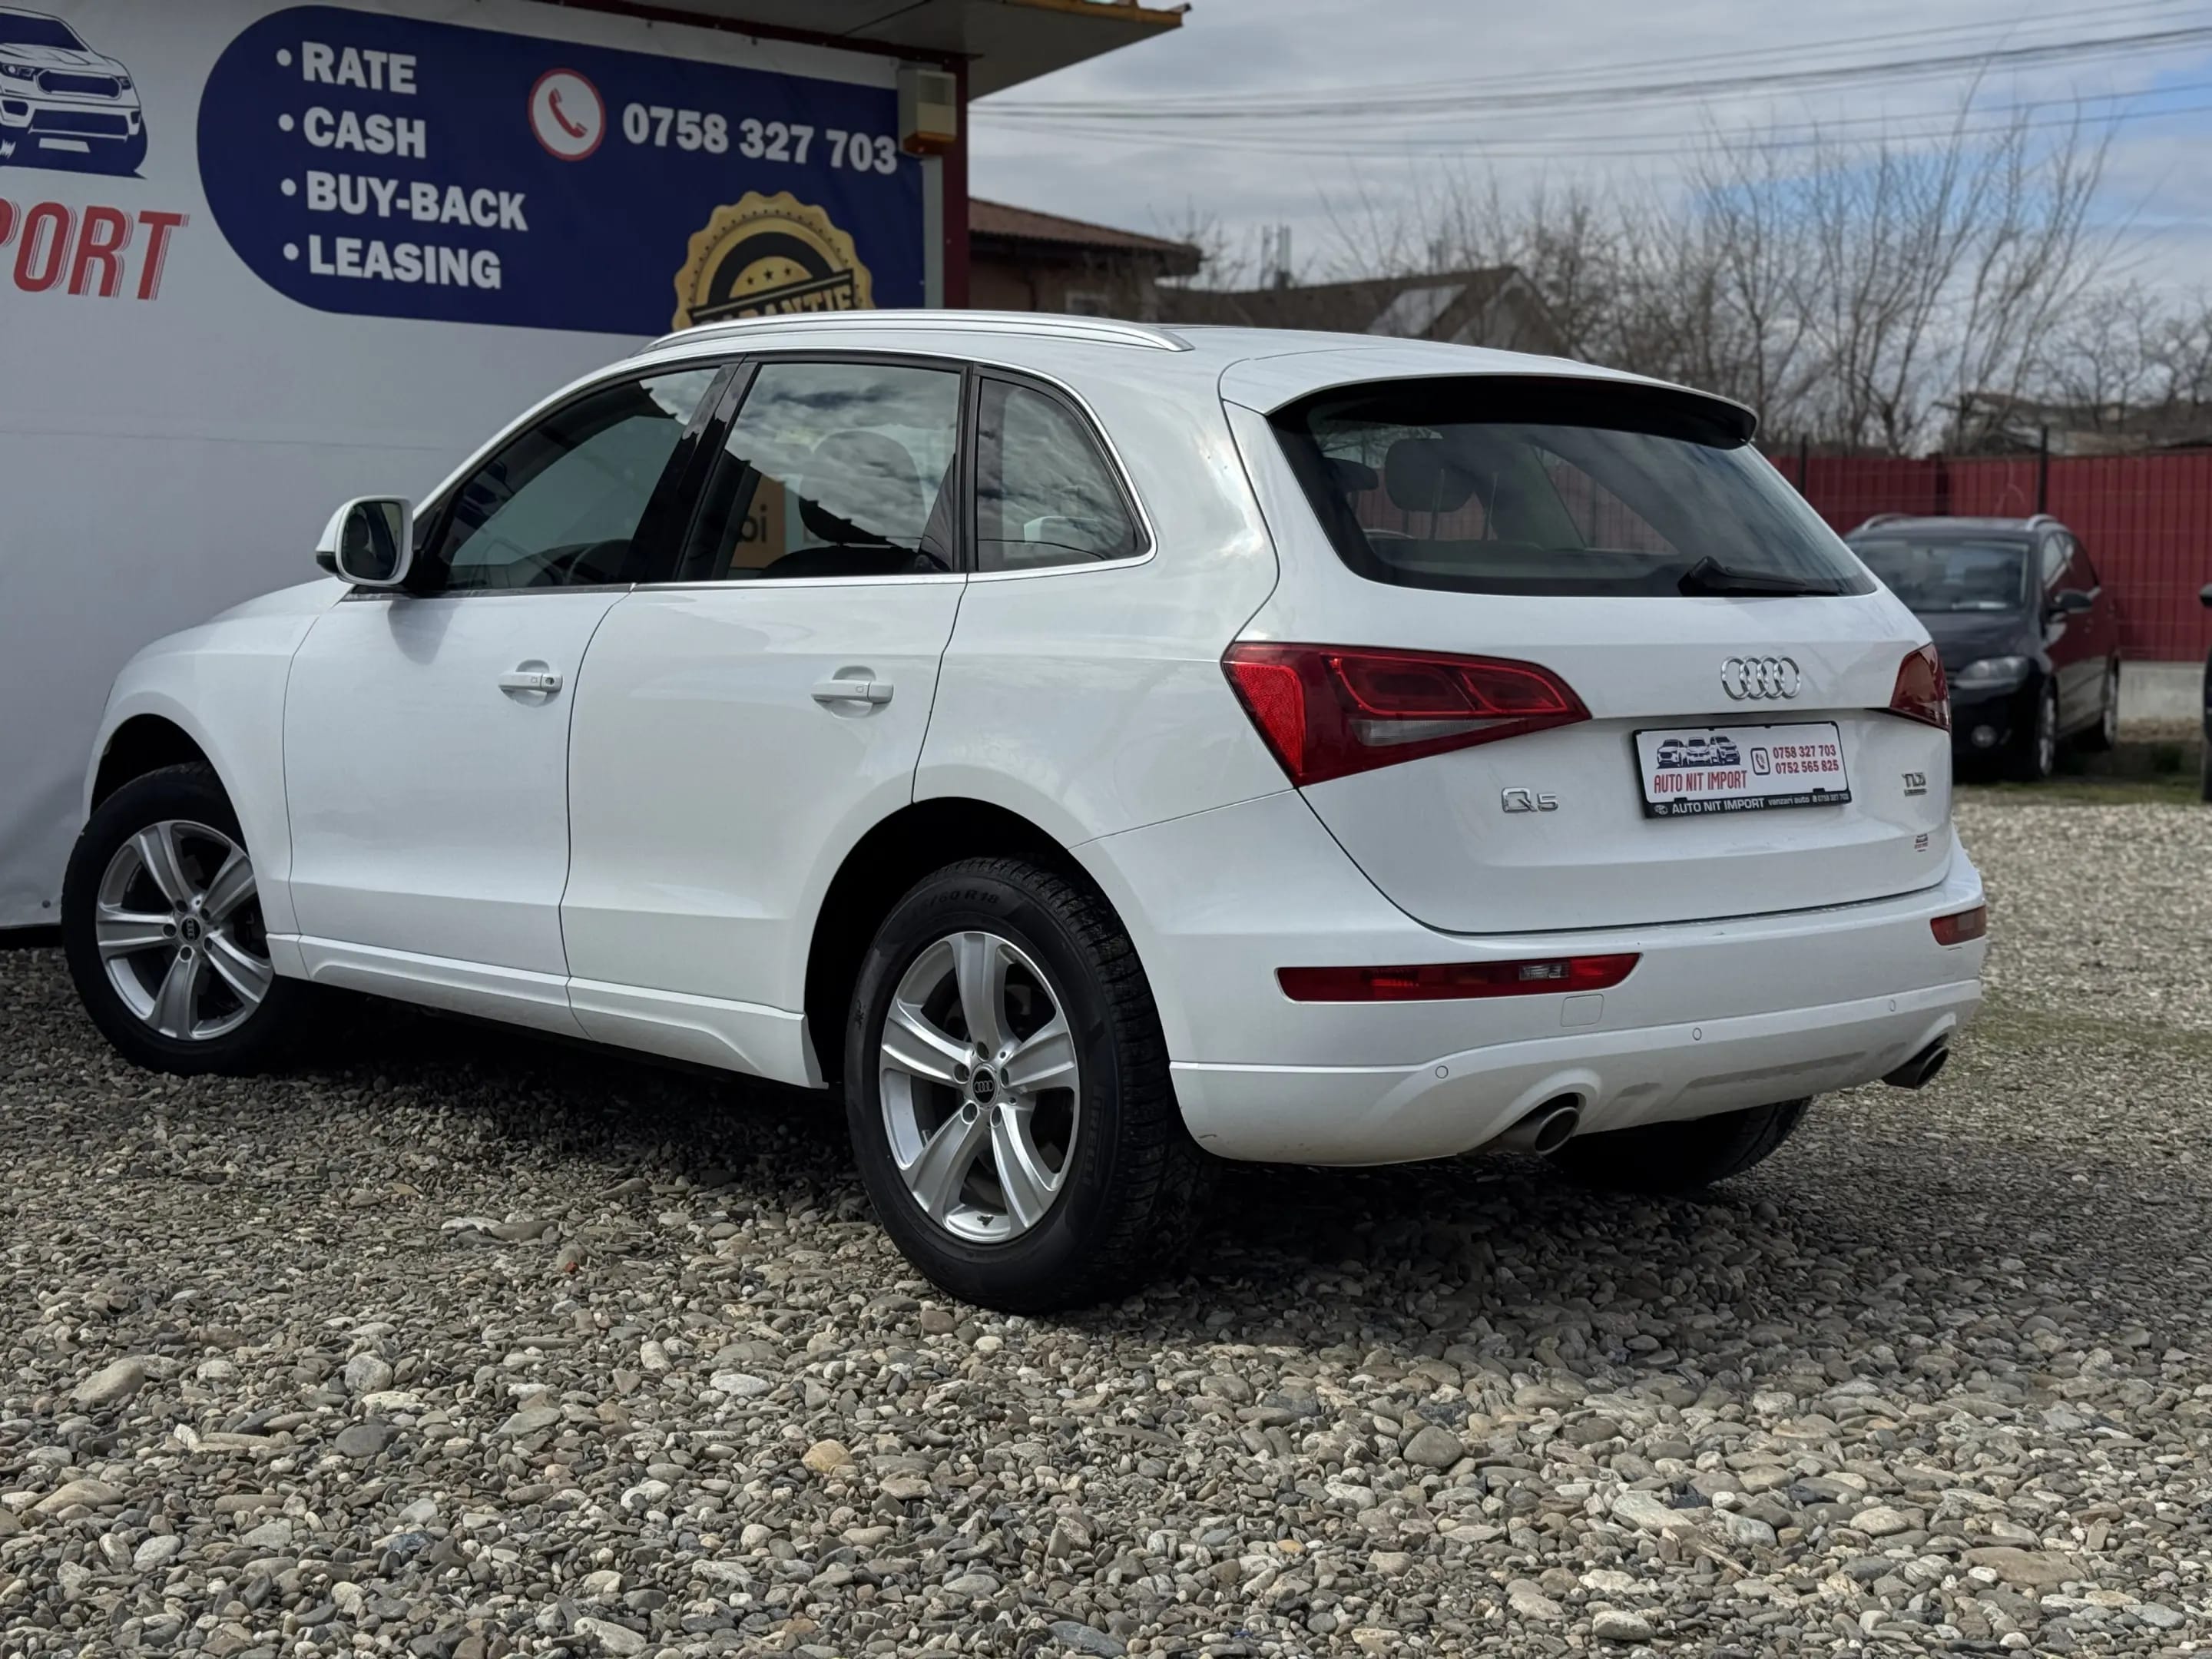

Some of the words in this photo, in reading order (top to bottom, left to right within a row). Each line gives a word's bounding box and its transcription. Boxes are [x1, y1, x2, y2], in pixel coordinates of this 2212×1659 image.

[301, 41, 417, 94] RATE
[303, 106, 426, 158] CASH
[622, 102, 728, 154] 0758
[739, 119, 813, 164] 327
[825, 128, 898, 175] 703
[306, 170, 528, 231] BUY-BACK
[309, 233, 502, 290] LEASING
[1773, 746, 1797, 759] 0758
[1799, 745, 1816, 758] 327
[1818, 743, 1836, 757] 703
[1775, 761, 1800, 775] 0752
[1801, 760, 1820, 773] 565
[1821, 759, 1839, 772] 825
[1502, 786, 1559, 813] Q5
[1654, 773, 1683, 793] AUTO
[1685, 772, 1704, 792] NIT
[1707, 770, 1747, 790] IMPORT
[1672, 803, 1702, 815] AUTO
[1704, 800, 1722, 812] NIT
[1724, 797, 1765, 811] IMPORT
